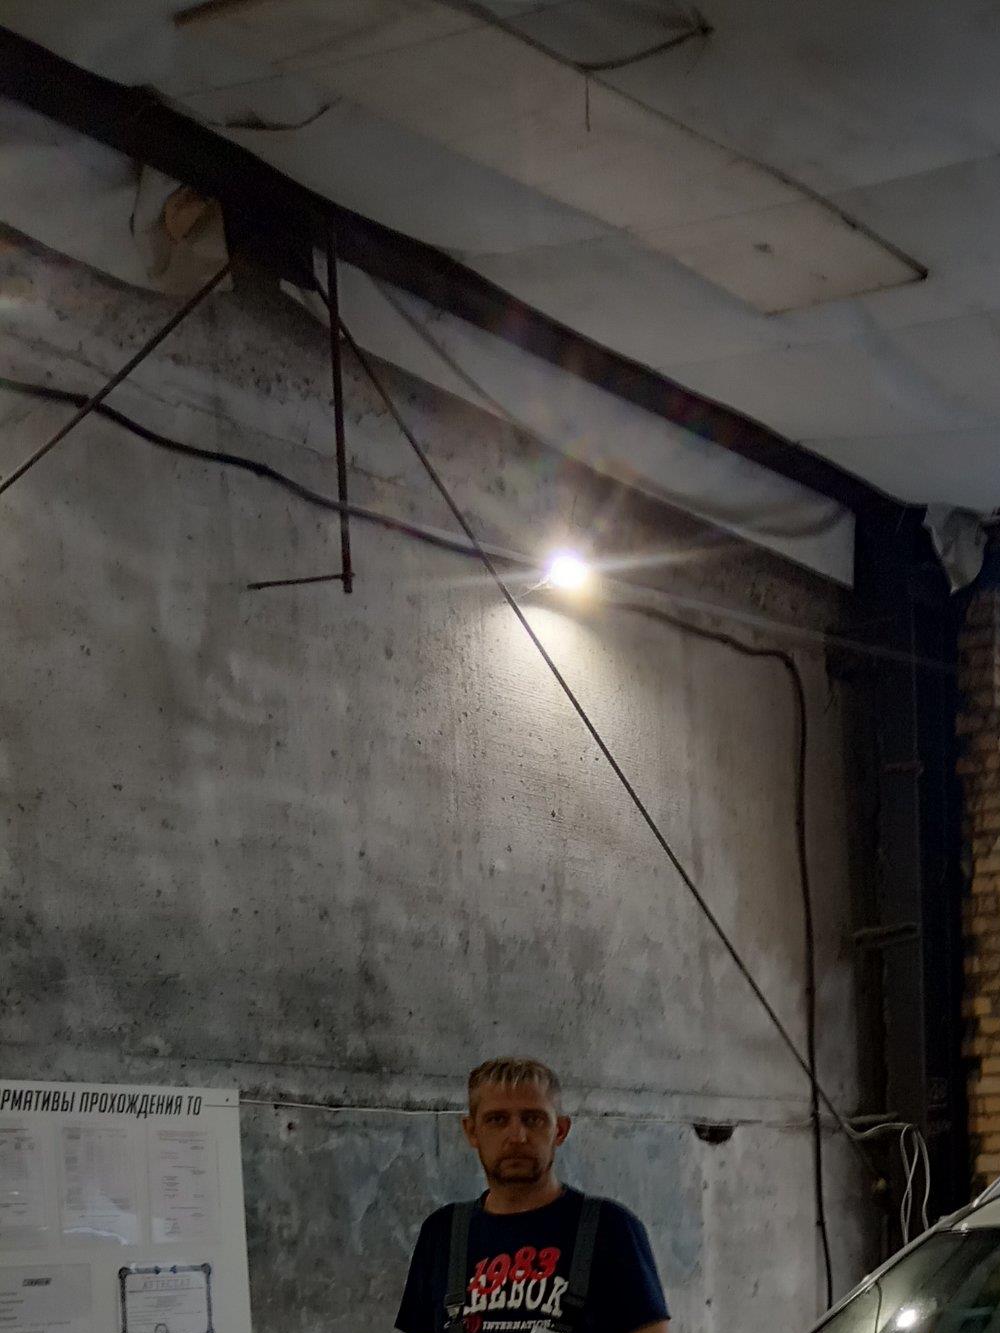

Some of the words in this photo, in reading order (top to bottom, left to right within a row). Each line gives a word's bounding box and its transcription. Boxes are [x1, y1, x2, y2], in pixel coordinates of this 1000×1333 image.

[0, 1088, 75, 1112] РМАТИВЫ
[79, 1092, 183, 1119] ПРОХОЖДЕНИЯ
[186, 1096, 202, 1116] ТО
